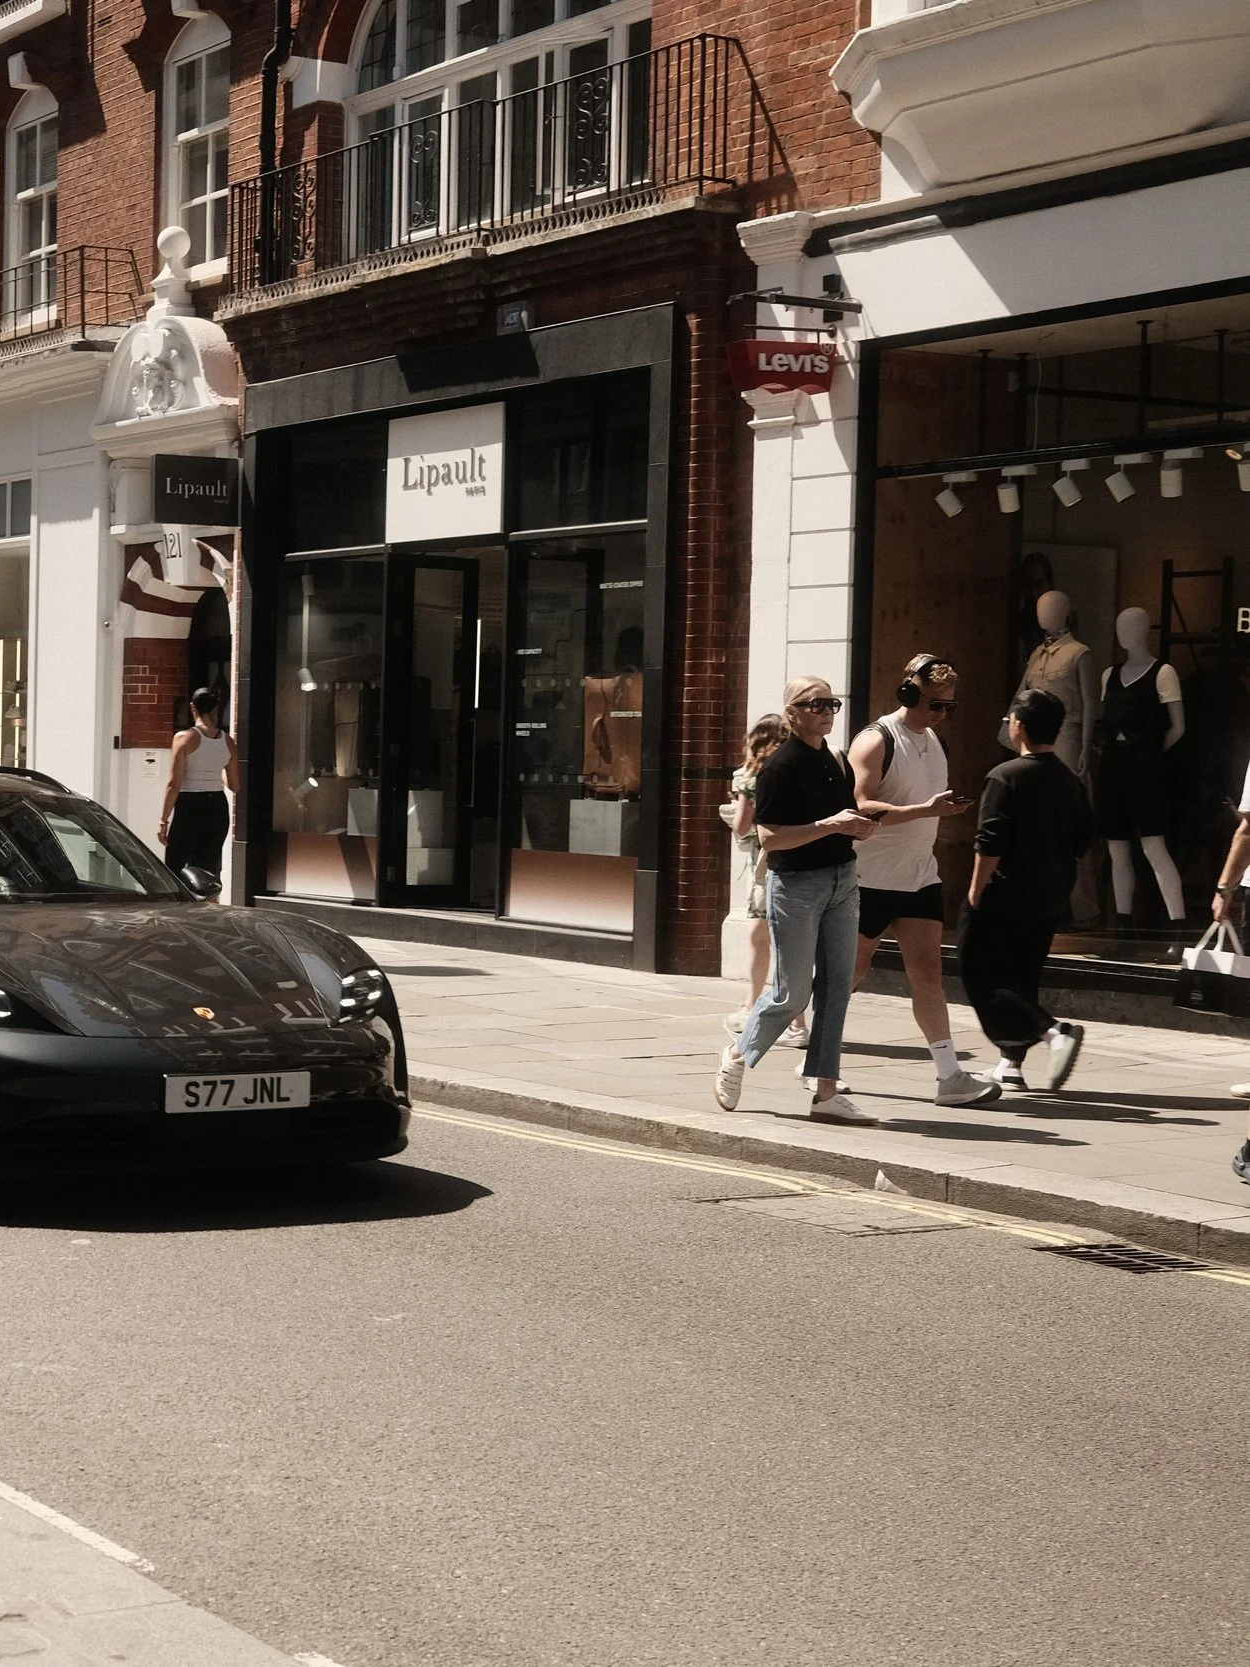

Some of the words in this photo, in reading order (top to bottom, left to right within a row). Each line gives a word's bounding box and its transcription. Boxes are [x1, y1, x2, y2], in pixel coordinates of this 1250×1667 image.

[402, 447, 487, 496] Lipault
[165, 477, 228, 499] Lipault
[163, 532, 182, 559] 121
[184, 1079, 235, 1108] S77
[243, 1076, 291, 1105] JNL
